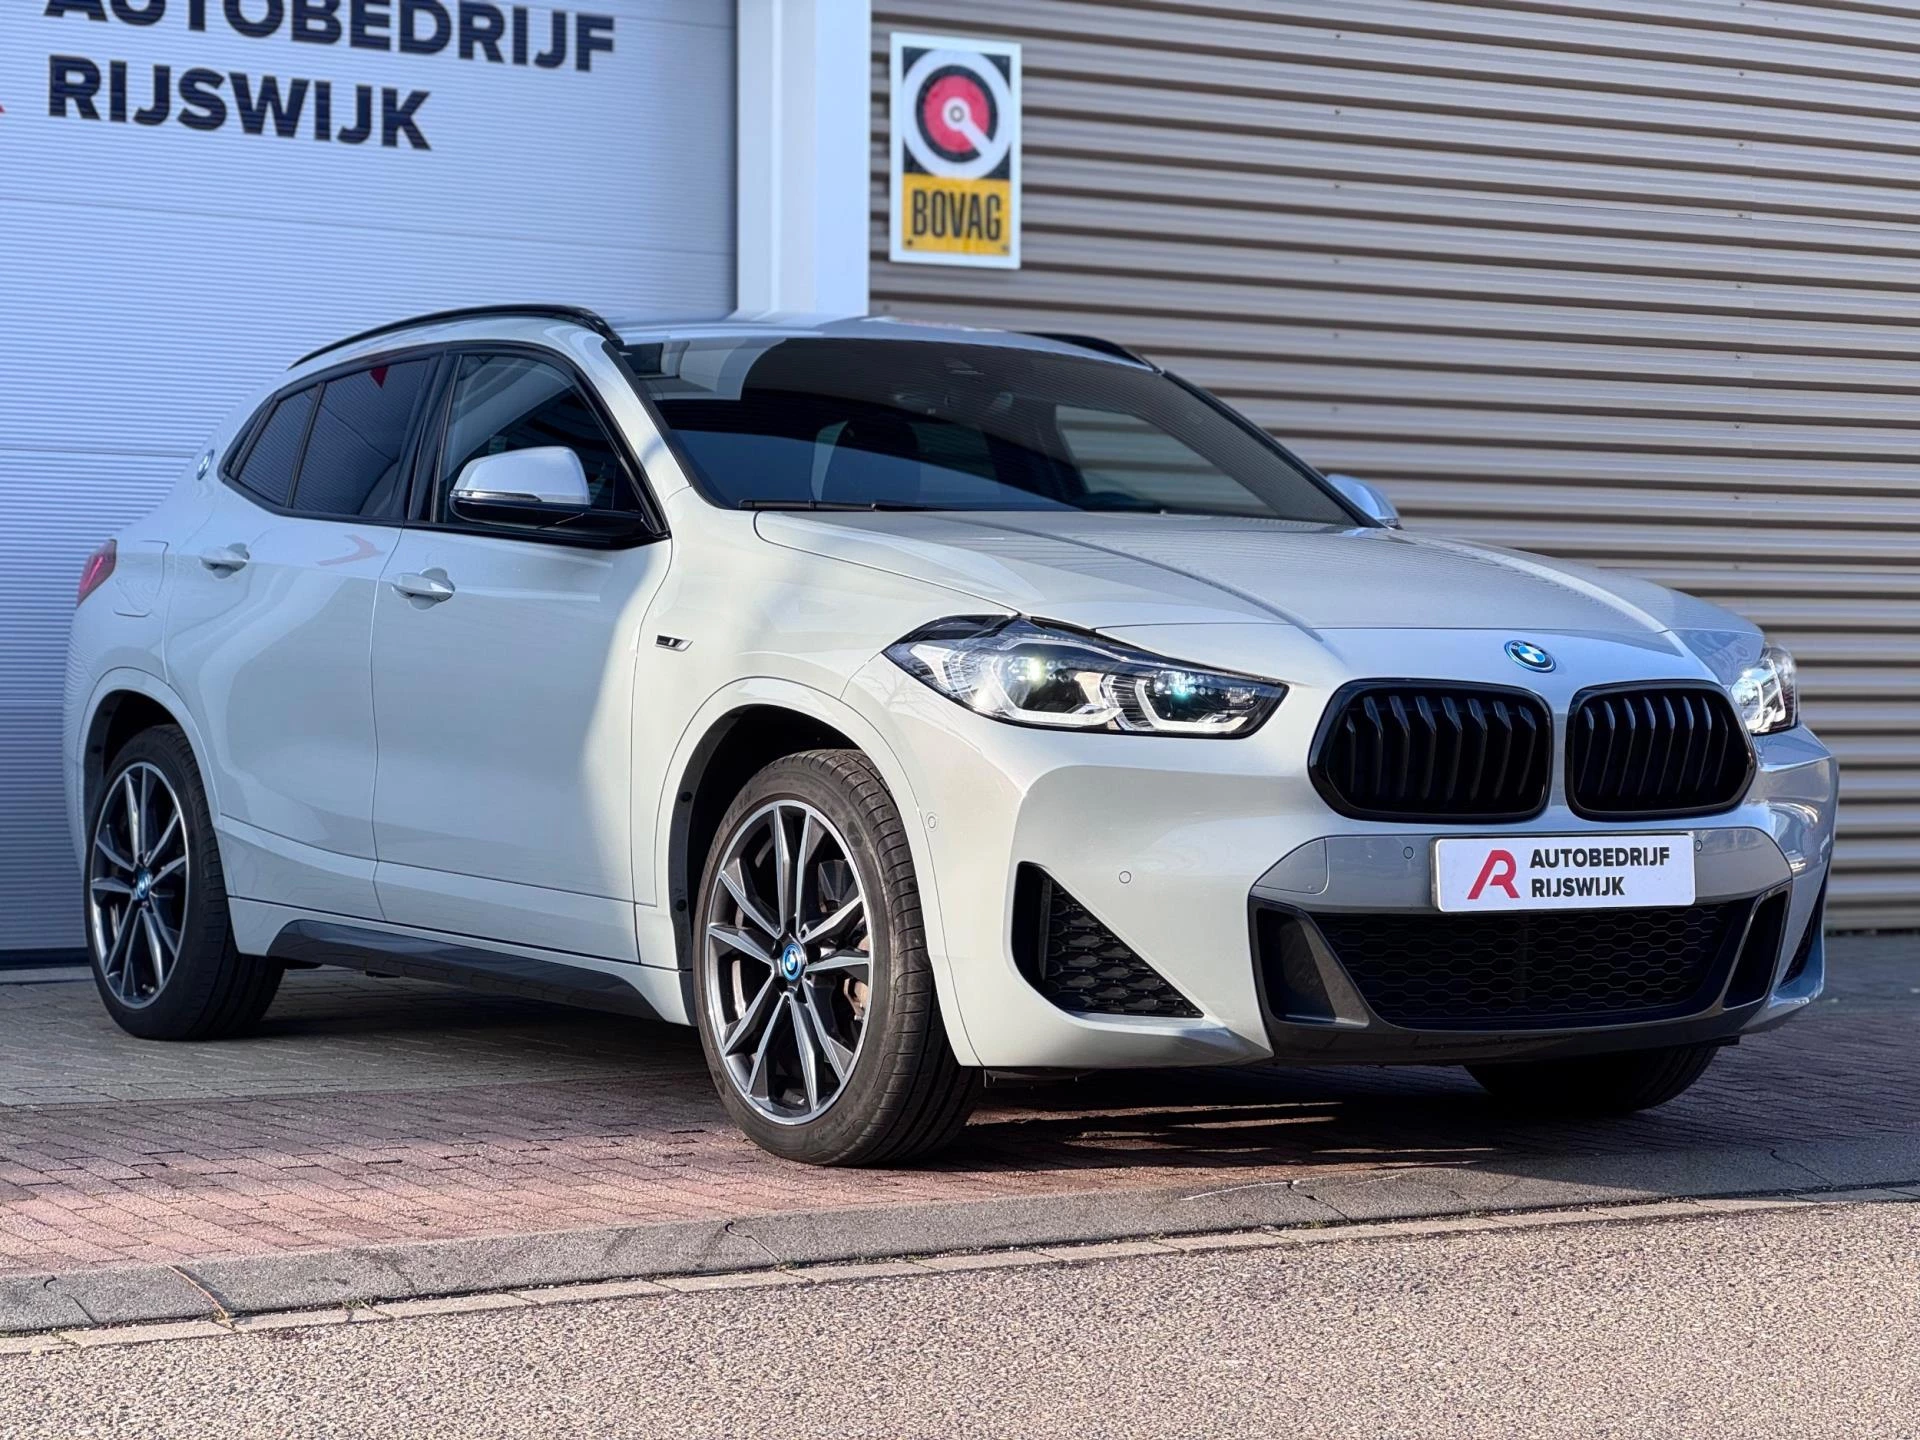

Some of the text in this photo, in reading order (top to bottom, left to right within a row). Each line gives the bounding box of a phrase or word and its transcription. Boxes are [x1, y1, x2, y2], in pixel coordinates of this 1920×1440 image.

[44, 0, 615, 72] OBEDRIJF
[48, 54, 432, 150] RIJSWIJK
[911, 188, 1001, 241] BOVAG
[1529, 846, 1671, 869] AUTOBEDRIJF
[1531, 876, 1626, 898] RIJSWIJK
